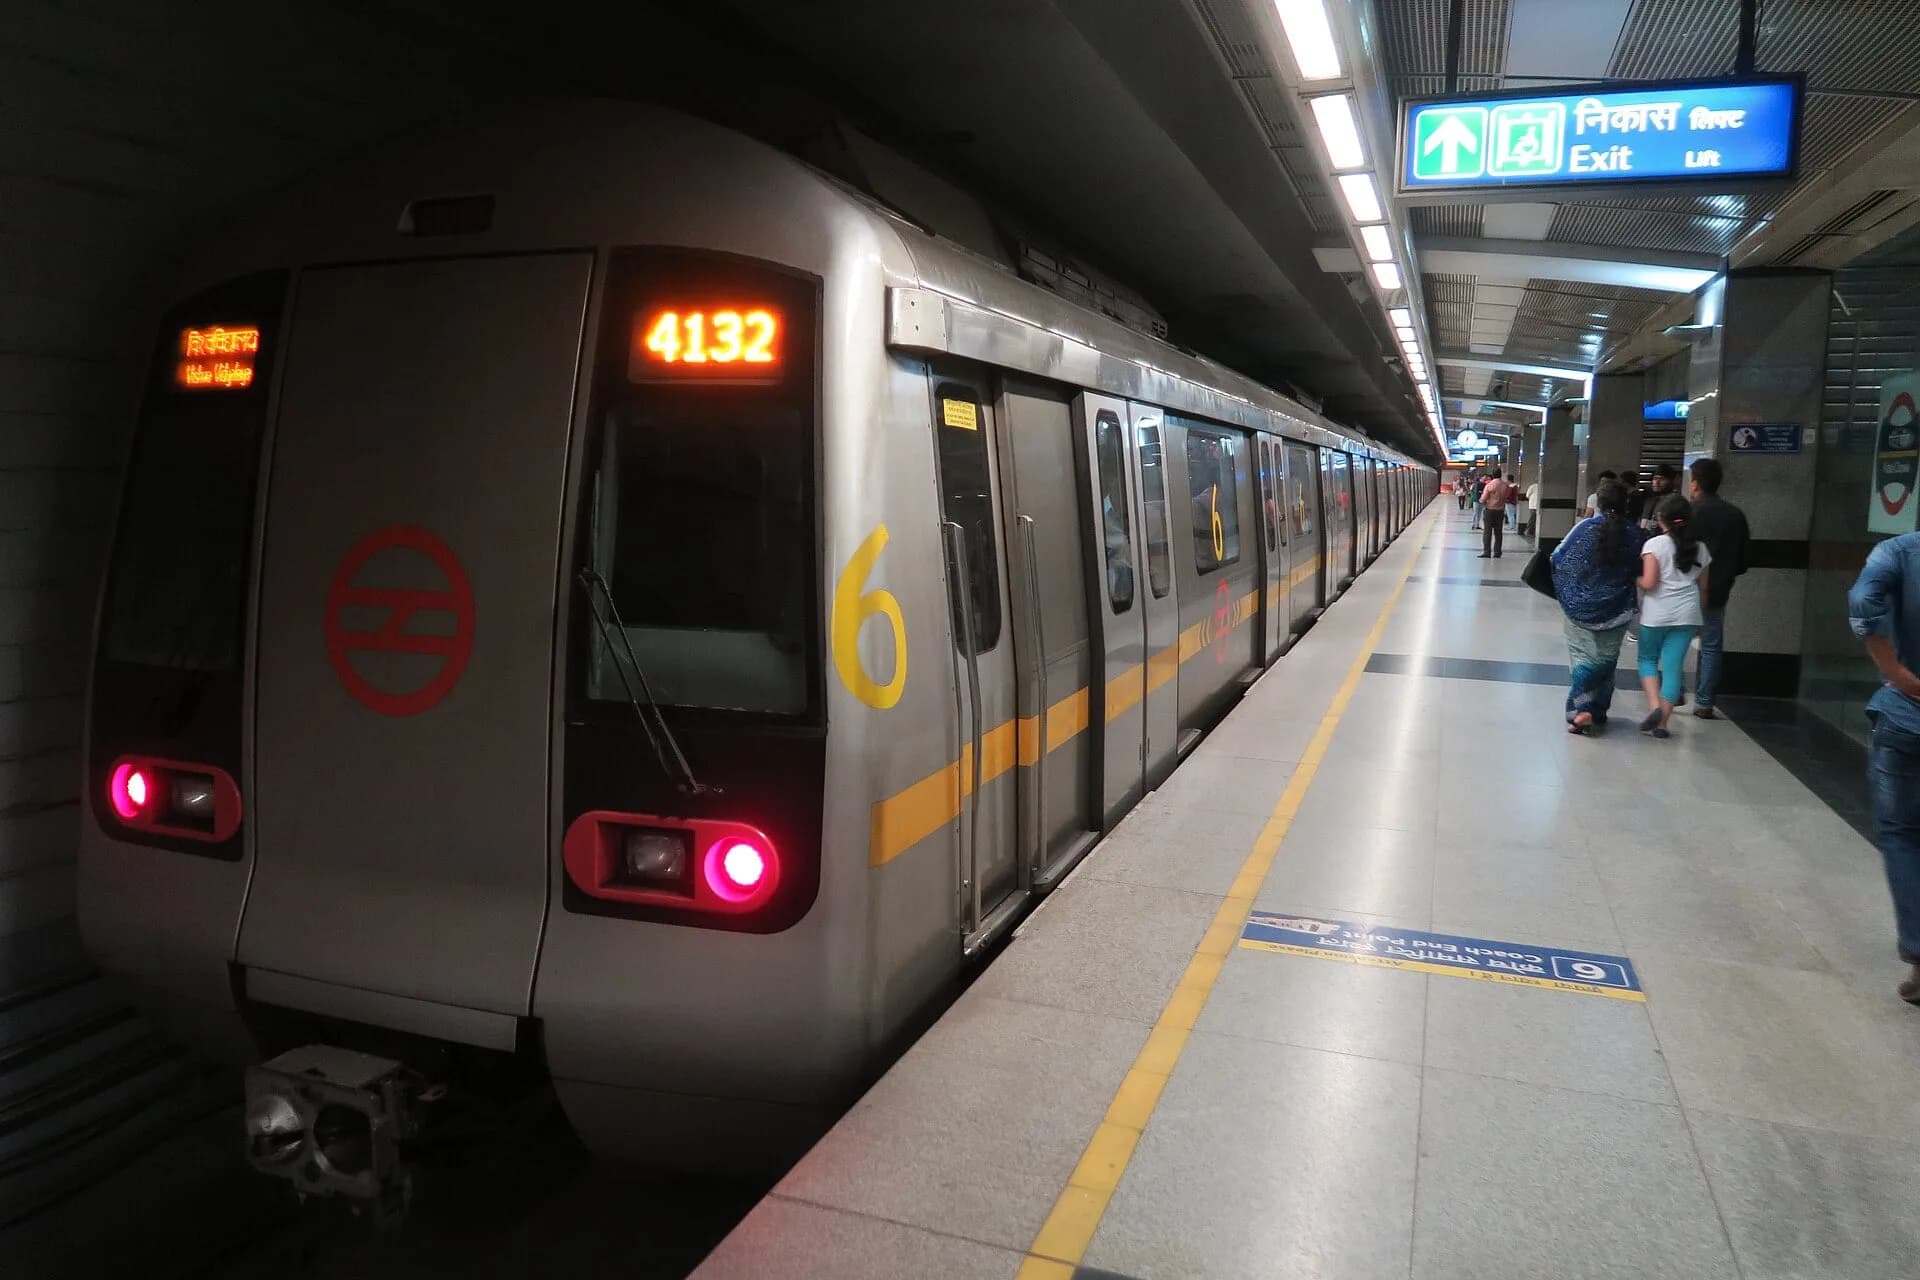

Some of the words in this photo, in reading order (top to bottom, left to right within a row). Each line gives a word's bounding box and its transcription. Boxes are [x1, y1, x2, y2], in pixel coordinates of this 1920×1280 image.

[1573, 97, 1682, 135] निकास
[1569, 144, 1633, 172] Exit
[1685, 149, 1721, 168] Lift
[647, 311, 776, 363] 4132
[1212, 483, 1224, 561] 6
[831, 522, 907, 710] 6
[1343, 930, 1405, 946] Point
[1412, 940, 1457, 953] End
[1385, 945, 1480, 965] समाप्ति
[1464, 946, 1543, 963] Coach
[1487, 959, 1546, 974] कोच
[1571, 962, 1607, 980] 6
